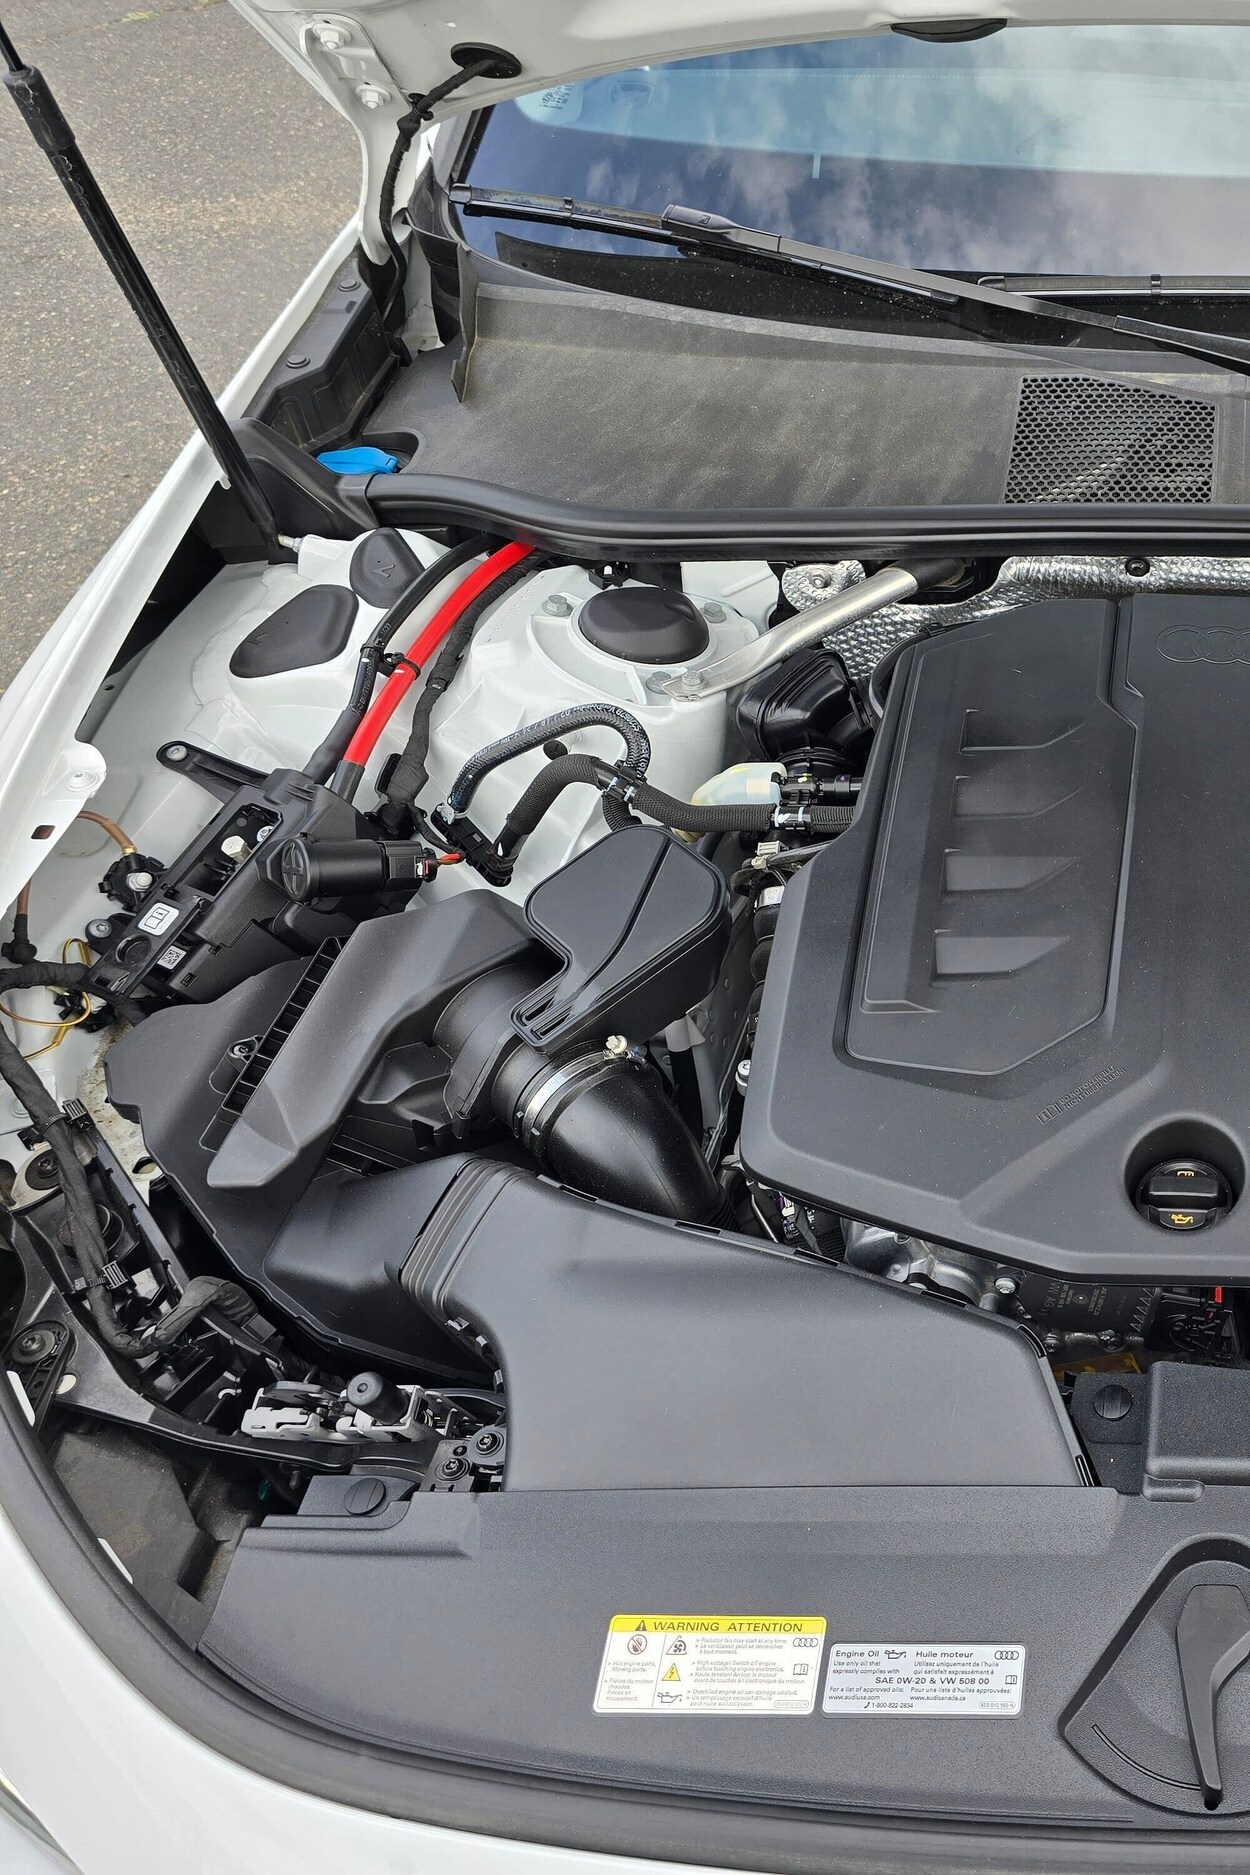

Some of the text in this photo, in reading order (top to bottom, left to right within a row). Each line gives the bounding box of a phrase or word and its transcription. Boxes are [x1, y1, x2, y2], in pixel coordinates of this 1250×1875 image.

[653, 1621, 803, 1632] WARNING ATTENTION
[835, 1650, 865, 1658] Engine
[875, 1676, 894, 1684] SAE
[978, 1677, 990, 1685] 00
